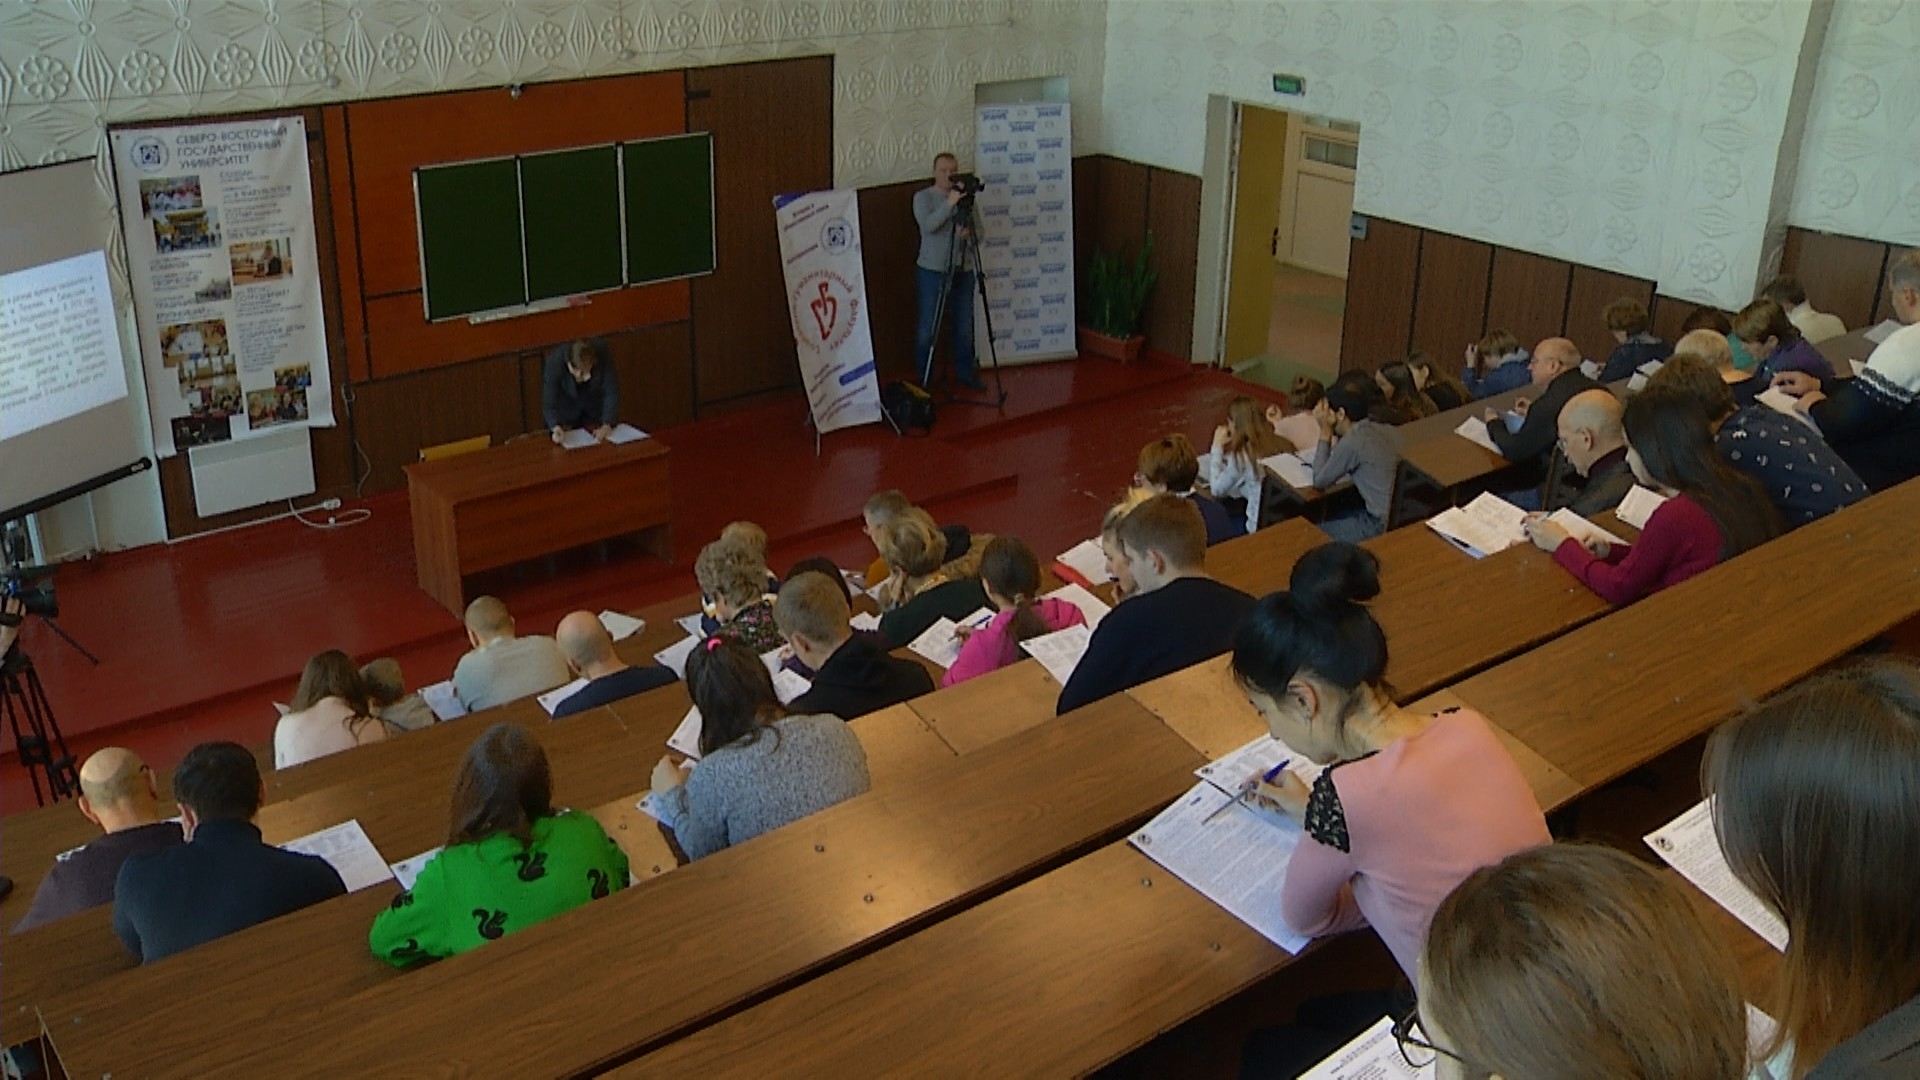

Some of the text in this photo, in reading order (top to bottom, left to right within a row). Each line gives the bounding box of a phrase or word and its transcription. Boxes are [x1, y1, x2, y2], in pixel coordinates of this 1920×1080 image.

[176, 127, 288, 145] СЕВЕРО-ВОСТОЧНЫЙ
[177, 140, 282, 157] ГОСУДАРСТВЕННЫЙ
[180, 155, 250, 169] УНИВЕРСИТЕТ
